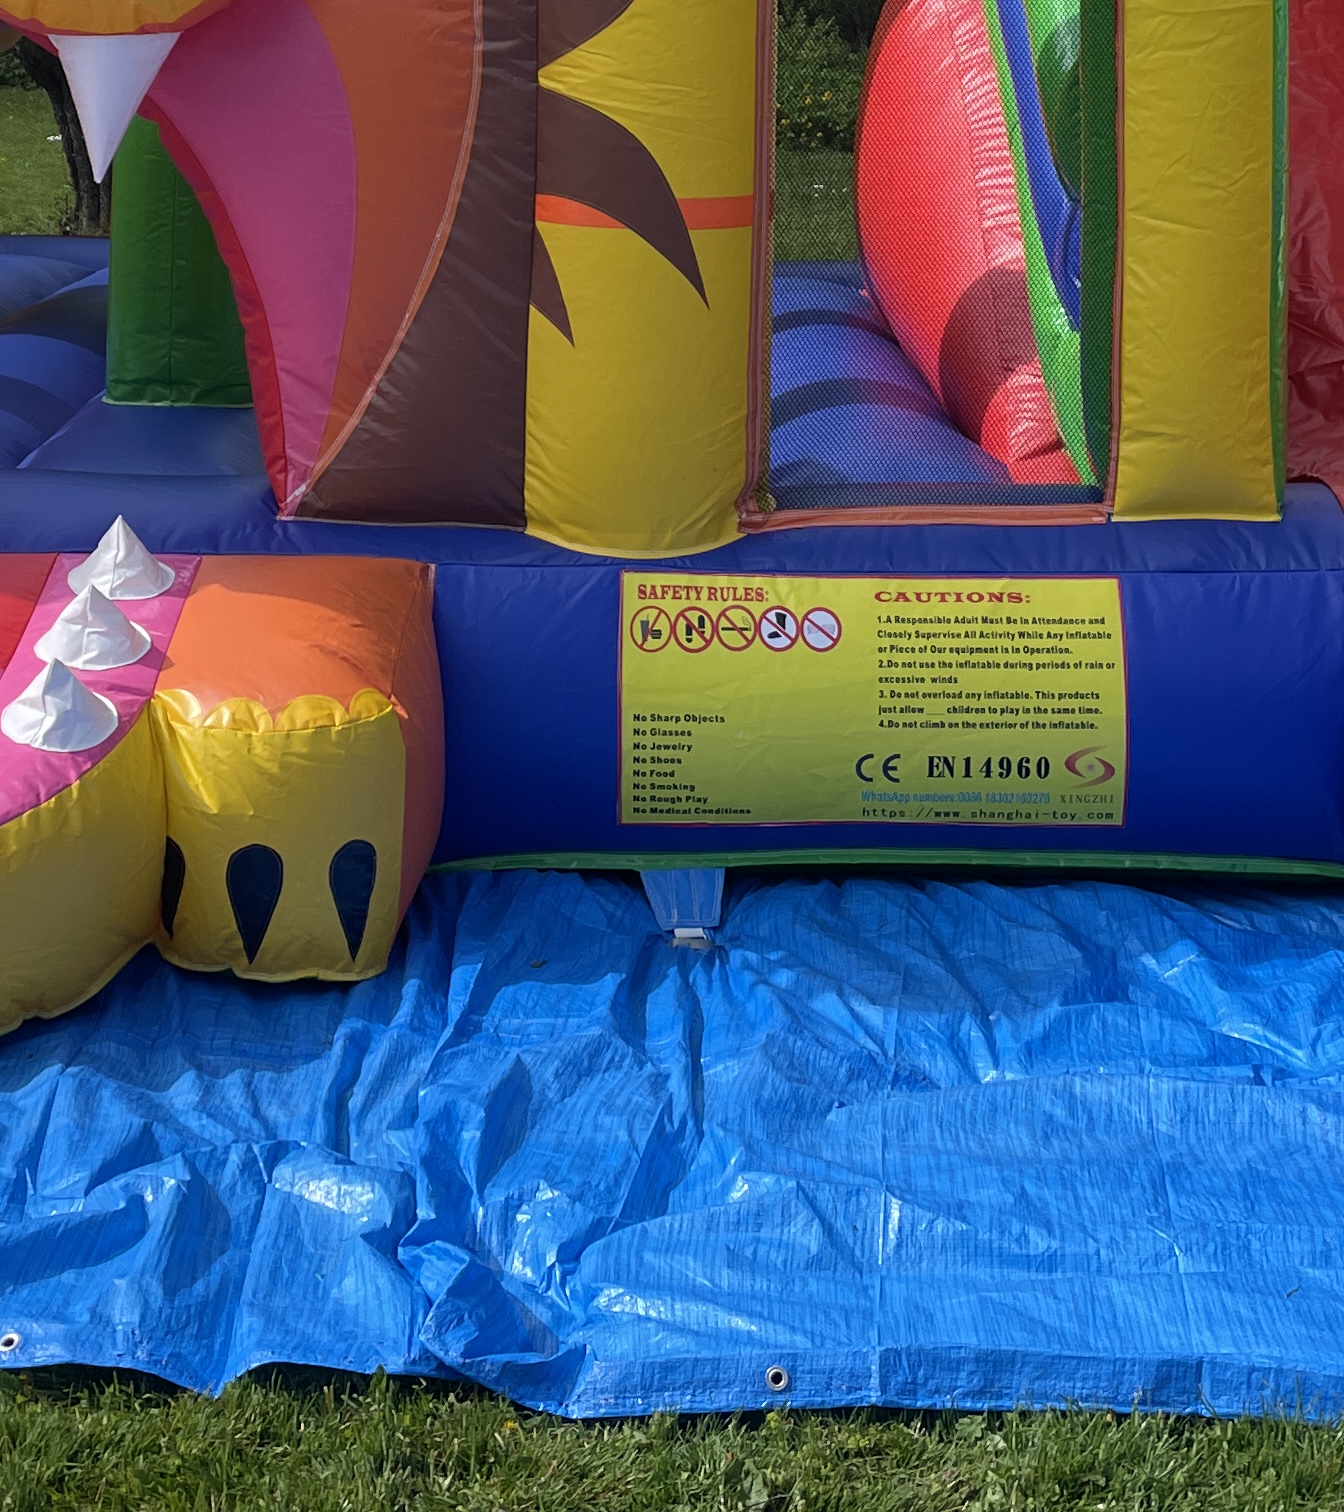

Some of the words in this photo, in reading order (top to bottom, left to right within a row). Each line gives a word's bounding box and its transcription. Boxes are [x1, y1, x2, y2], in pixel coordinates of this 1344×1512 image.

[637, 584, 704, 601] SAFETY
[706, 586, 769, 602] RULES:
[874, 591, 1031, 604] CAUTIONS:
[894, 615, 951, 625] Responsible
[954, 615, 979, 625] Adult
[981, 615, 1003, 625] Must
[1006, 615, 1018, 625] Be
[1031, 615, 1086, 625] Attendance
[1088, 615, 1105, 625] and
[877, 630, 912, 641] Closely
[914, 630, 961, 641] Supervise
[963, 630, 976, 639] All
[978, 630, 1015, 641] Activity
[1017, 631, 1044, 639] While
[1045, 631, 1064, 641] Any
[1066, 631, 1112, 639] Inflatable
[877, 646, 887, 654] or
[889, 644, 916, 654] Piece
[918, 645, 927, 654] of
[930, 645, 947, 654] Our
[949, 645, 999, 655] equipment
[1022, 646, 1073, 656] Operation.
[878, 659, 899, 668] 2.Do
[901, 660, 917, 668] not
[938, 660, 953, 668] the
[956, 660, 1001, 669] inflatable
[1003, 660, 1033, 671] during
[1035, 660, 1071, 671] periods
[1073, 661, 1082, 669] of
[1085, 661, 1104, 669] rain
[878, 675, 926, 684] excessive
[930, 675, 958, 684] winds
[878, 690, 888, 699] 3.
[889, 690, 902, 699] Do
[904, 690, 919, 699] not
[921, 690, 963, 699] overload
[964, 691, 982, 701] any
[983, 690, 1033, 699] inflatable.
[1035, 690, 1056, 699] This
[1057, 691, 1100, 701] products
[878, 705, 897, 715] just
[899, 705, 925, 714] allow
[946, 705, 986, 714] children
[987, 705, 998, 714] to
[999, 706, 1020, 716] play
[1022, 706, 1031, 714] in
[1033, 706, 1048, 714] the
[1078, 706, 1103, 714] time.
[632, 713, 647, 722] No
[649, 713, 681, 724] Sharp
[683, 713, 725, 724] Objects
[878, 720, 899, 728] 4.Do
[902, 720, 917, 729] not
[919, 720, 946, 729] climb
[961, 720, 977, 729] the
[979, 720, 1018, 729] exterior
[1019, 721, 1029, 729] of
[1031, 721, 1047, 729] the
[1048, 721, 1098, 730] inflatable.
[632, 728, 647, 736] No
[649, 728, 692, 736] Glasses
[632, 742, 647, 750] No
[649, 742, 693, 752] Jewelry
[632, 756, 647, 764] No
[649, 756, 682, 764] Shoes
[632, 769, 647, 777] No
[649, 769, 675, 777] Food
[632, 782, 647, 790] No
[649, 782, 696, 792] Smoking
[632, 795, 647, 803] No
[649, 795, 683, 804] Rough
[685, 795, 708, 804] Play
[861, 791, 910, 804] WhatsApp
[1059, 794, 1115, 804] XINGZHI
[694, 807, 751, 815] Conditions
